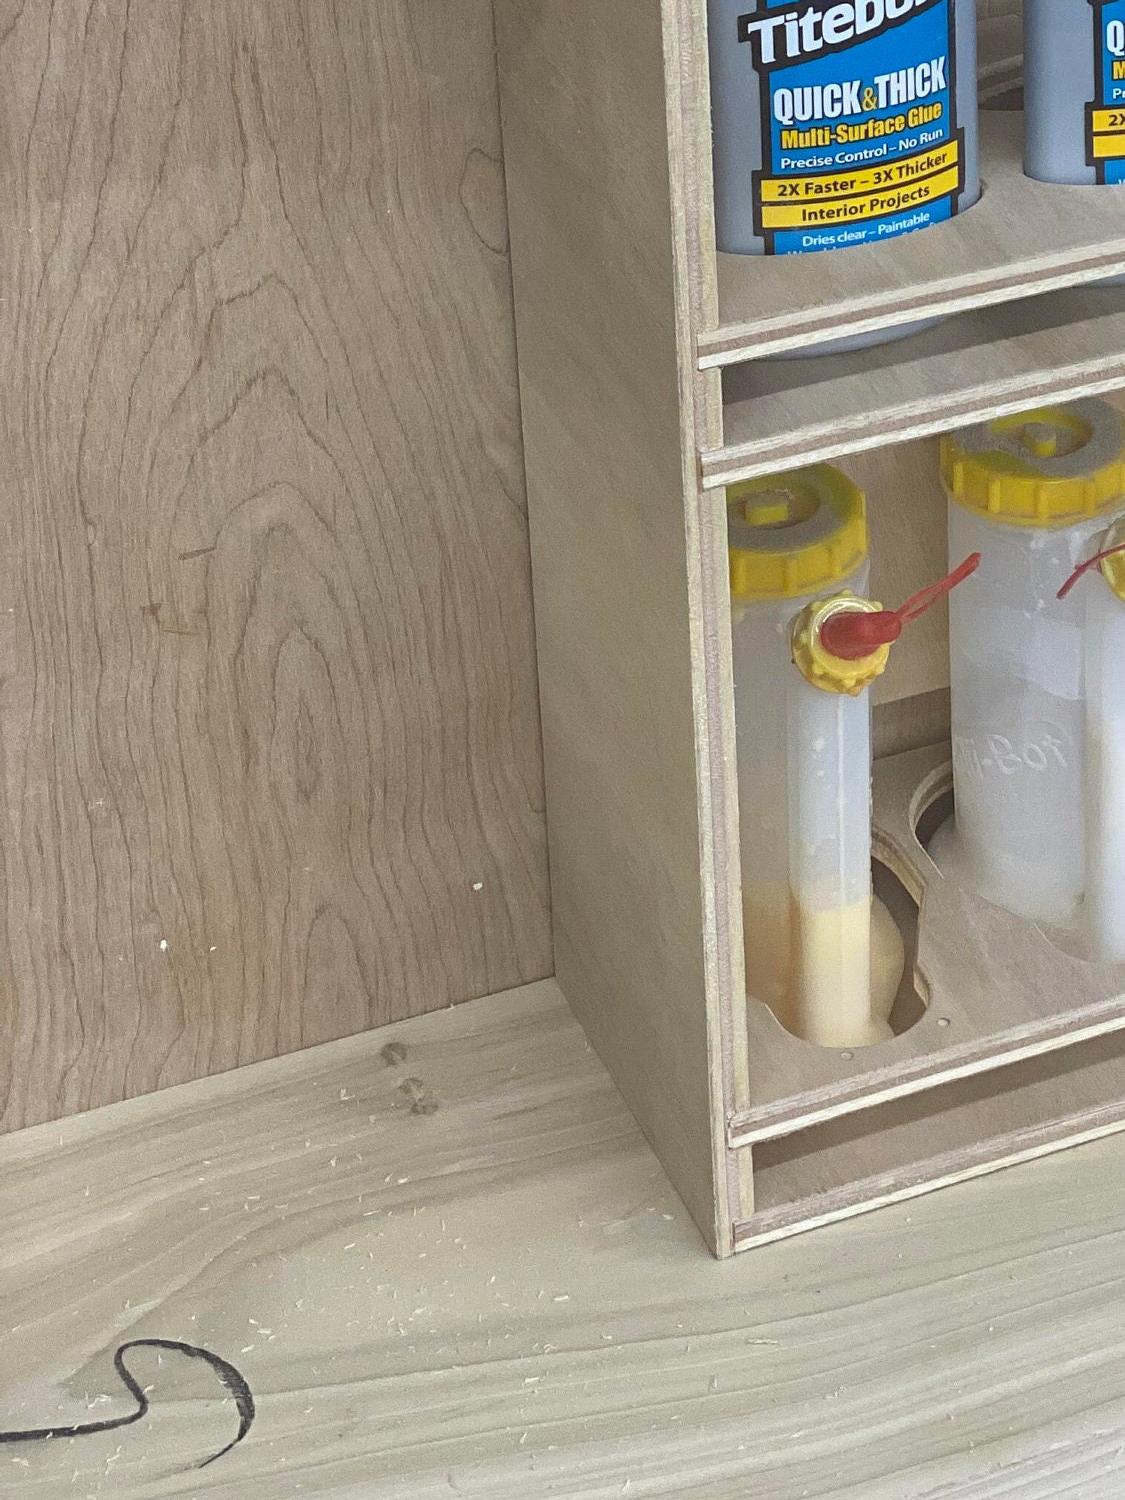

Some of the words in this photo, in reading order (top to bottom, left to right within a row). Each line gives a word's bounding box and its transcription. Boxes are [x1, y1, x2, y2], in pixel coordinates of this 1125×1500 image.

[780, 113, 906, 150] Multi-Surface
[907, 101, 943, 129] Glue
[780, 155, 834, 169] Precise
[835, 143, 887, 164] Control
[898, 138, 918, 152] No
[919, 129, 943, 145] Run
[777, 183, 800, 197] 2X
[804, 178, 856, 195] Faster
[873, 168, 894, 185] 3X
[896, 152, 948, 179] Thicker
[802, 202, 866, 222] Interior
[870, 185, 930, 212] Projects
[802, 234, 835, 247] Dries
[837, 230, 867, 243] clear
[878, 212, 930, 235] Paintable
